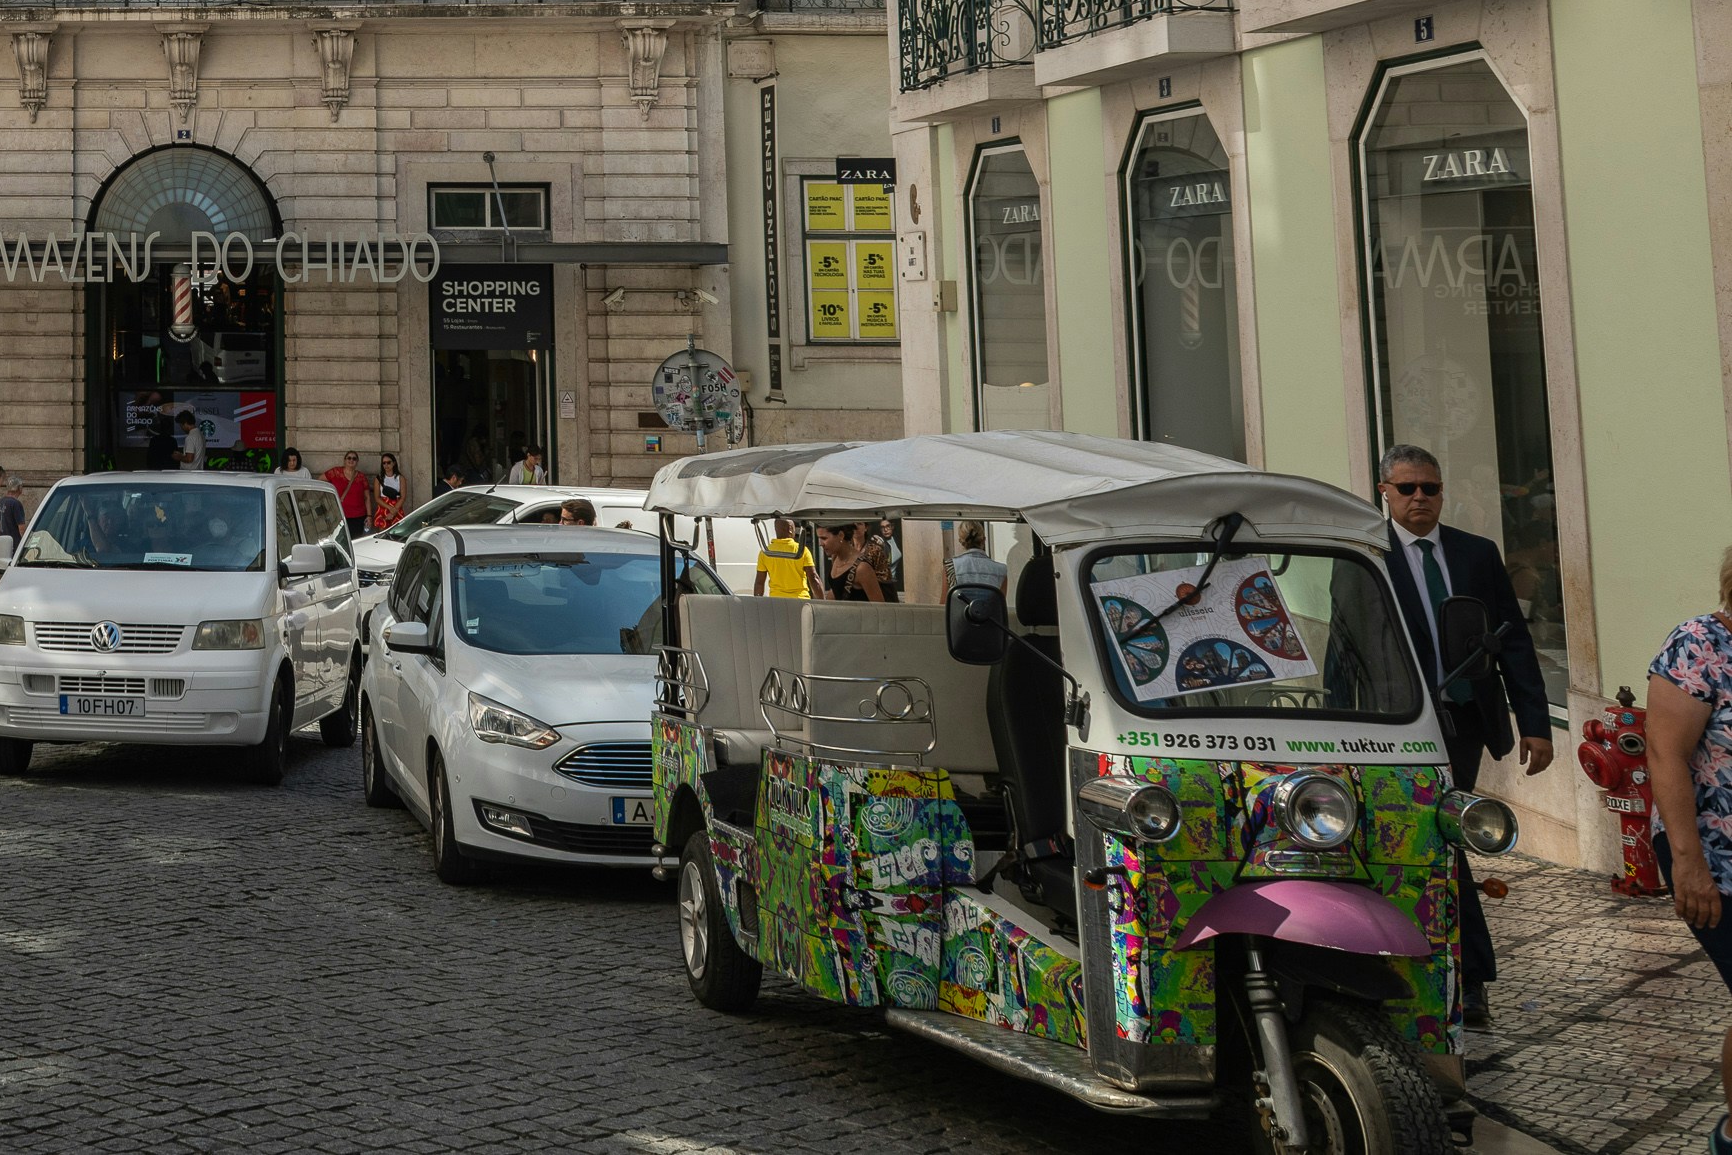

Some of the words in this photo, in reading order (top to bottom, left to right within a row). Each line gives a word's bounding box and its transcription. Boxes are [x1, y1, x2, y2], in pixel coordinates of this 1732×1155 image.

[1420, 18, 1428, 40] 5
[764, 93, 772, 191] CENTER
[840, 169, 892, 179] ZARA
[1423, 148, 1509, 181] ZARA
[1170, 182, 1224, 208] ZARA
[1002, 204, 1040, 224] ZARA
[190, 231, 253, 283] DO
[275, 231, 441, 283] CHIADO
[766, 199, 777, 331] SHOPPING
[818, 256, 839, 268] -5%
[863, 253, 884, 266] -5%
[442, 281, 541, 296] SHOPPING
[442, 298, 517, 313] CENTER
[817, 304, 845, 316] -10%
[868, 302, 888, 314] -5%
[1116, 731, 1159, 747] +351
[1163, 733, 1200, 749] 926
[1205, 734, 1239, 750] 373
[1243, 736, 1276, 752] 031
